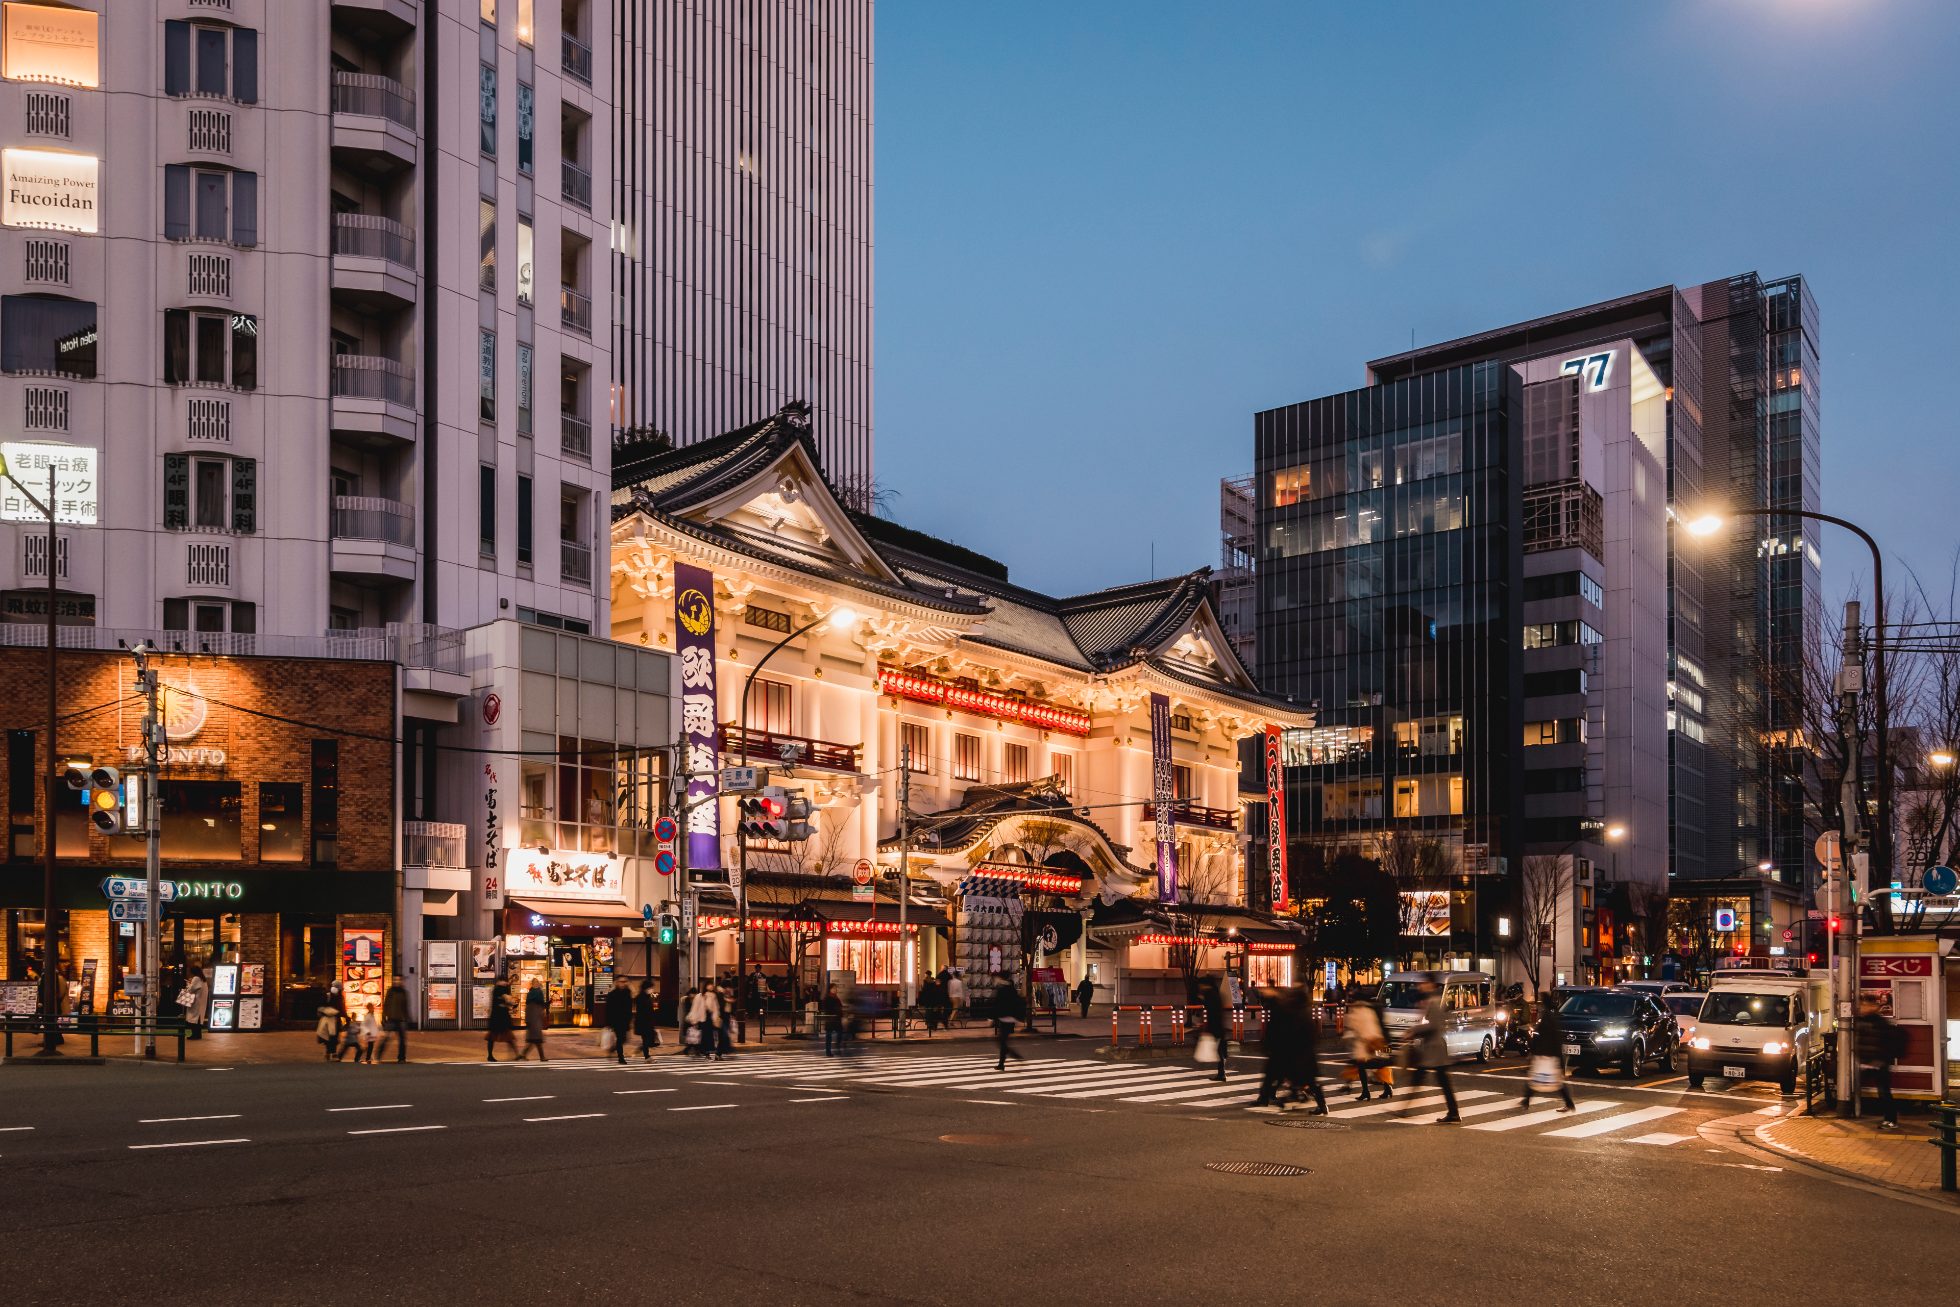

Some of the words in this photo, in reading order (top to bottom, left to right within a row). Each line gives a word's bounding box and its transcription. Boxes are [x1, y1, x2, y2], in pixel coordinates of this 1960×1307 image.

[10, 173, 60, 187] Amaizing
[63, 177, 96, 188] Power
[10, 189, 93, 210] Fucoidan
[481, 333, 492, 378] 茶道教室
[1564, 352, 1611, 387] 77
[520, 365, 529, 408] Ceremony
[15, 453, 88, 473] 老眼治療
[129, 748, 226, 766] PONTO
[484, 788, 499, 869] 富士そば
[485, 877, 498, 890] 24
[546, 860, 609, 889] 富士そば
[113, 884, 125, 892] 304
[177, 882, 242, 898] ONTO
[485, 890, 498, 900] 時間
[1866, 958, 1922, 975] 宝くじ
[112, 1007, 134, 1016] OPEN
